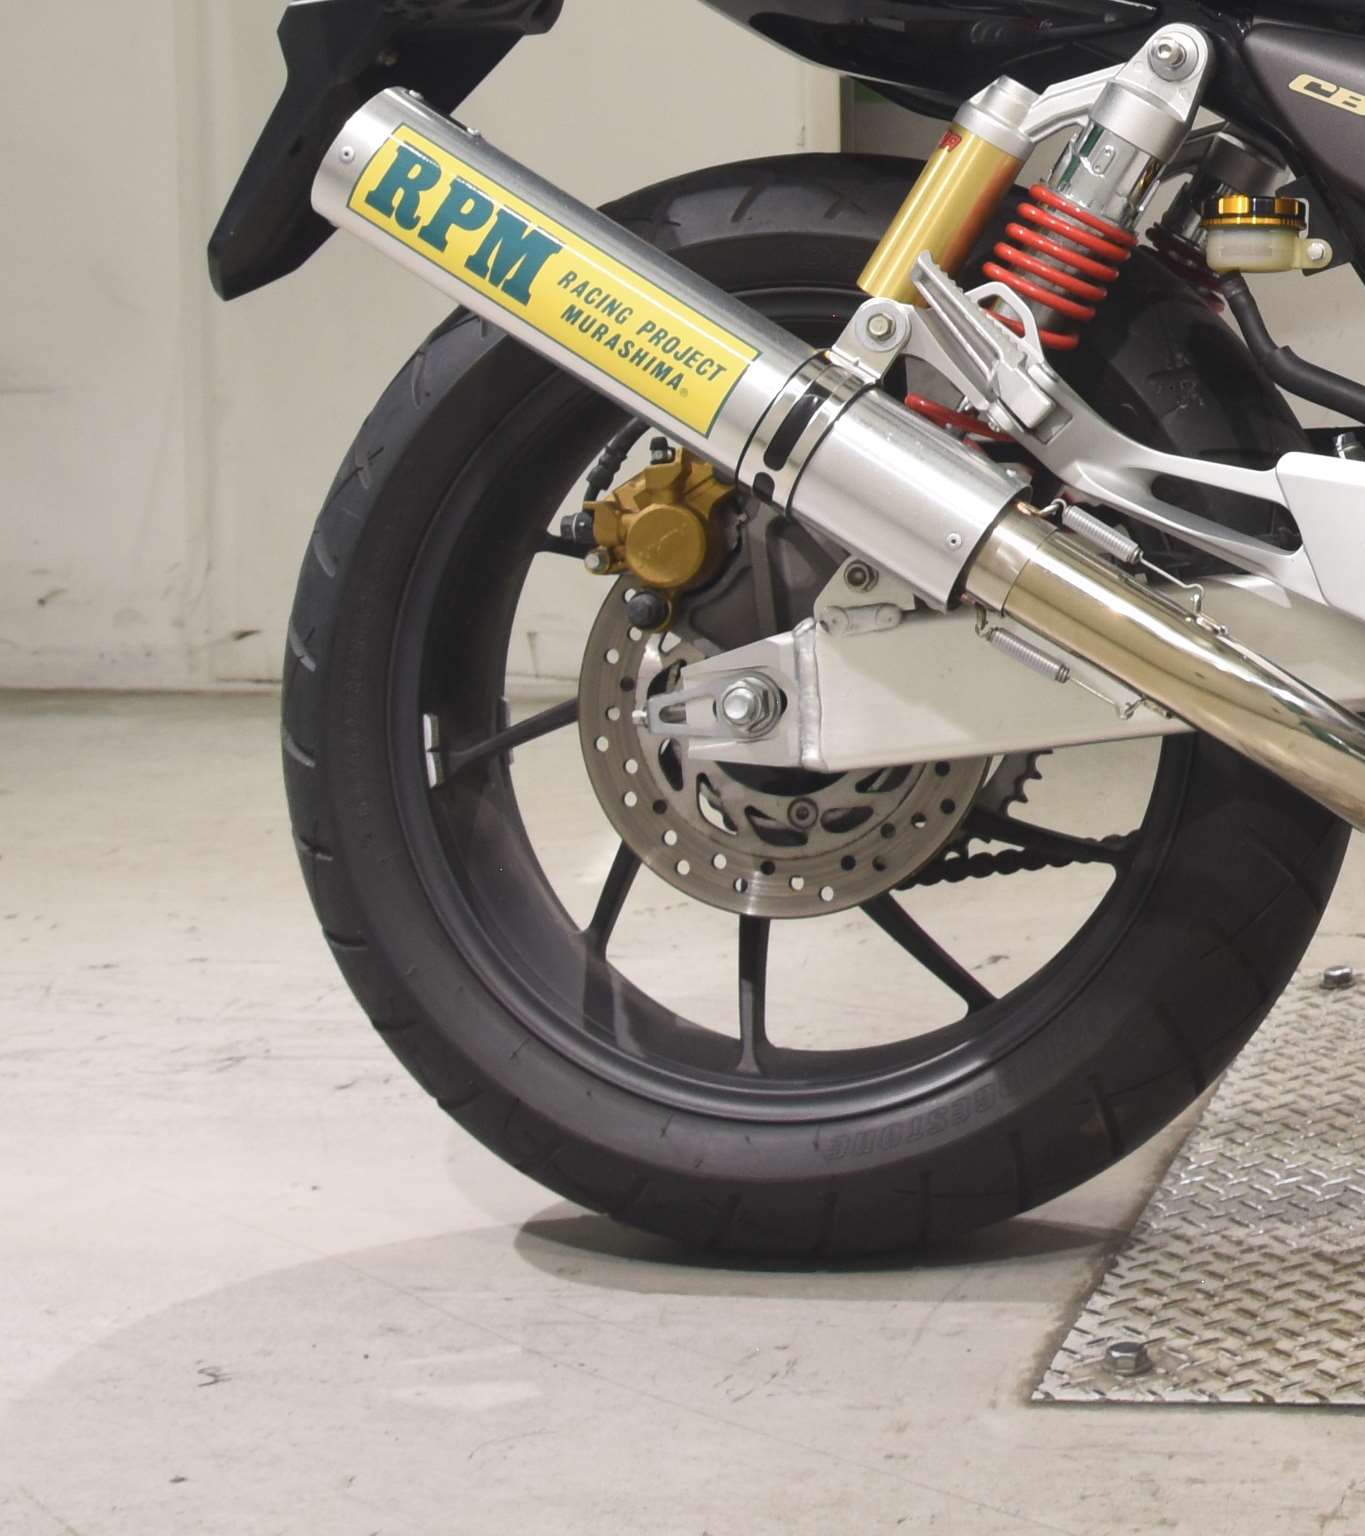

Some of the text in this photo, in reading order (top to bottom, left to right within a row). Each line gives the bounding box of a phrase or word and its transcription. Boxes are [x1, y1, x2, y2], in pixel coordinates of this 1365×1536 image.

[364, 140, 567, 306] RPM
[557, 270, 728, 383] RACING PROJECT
